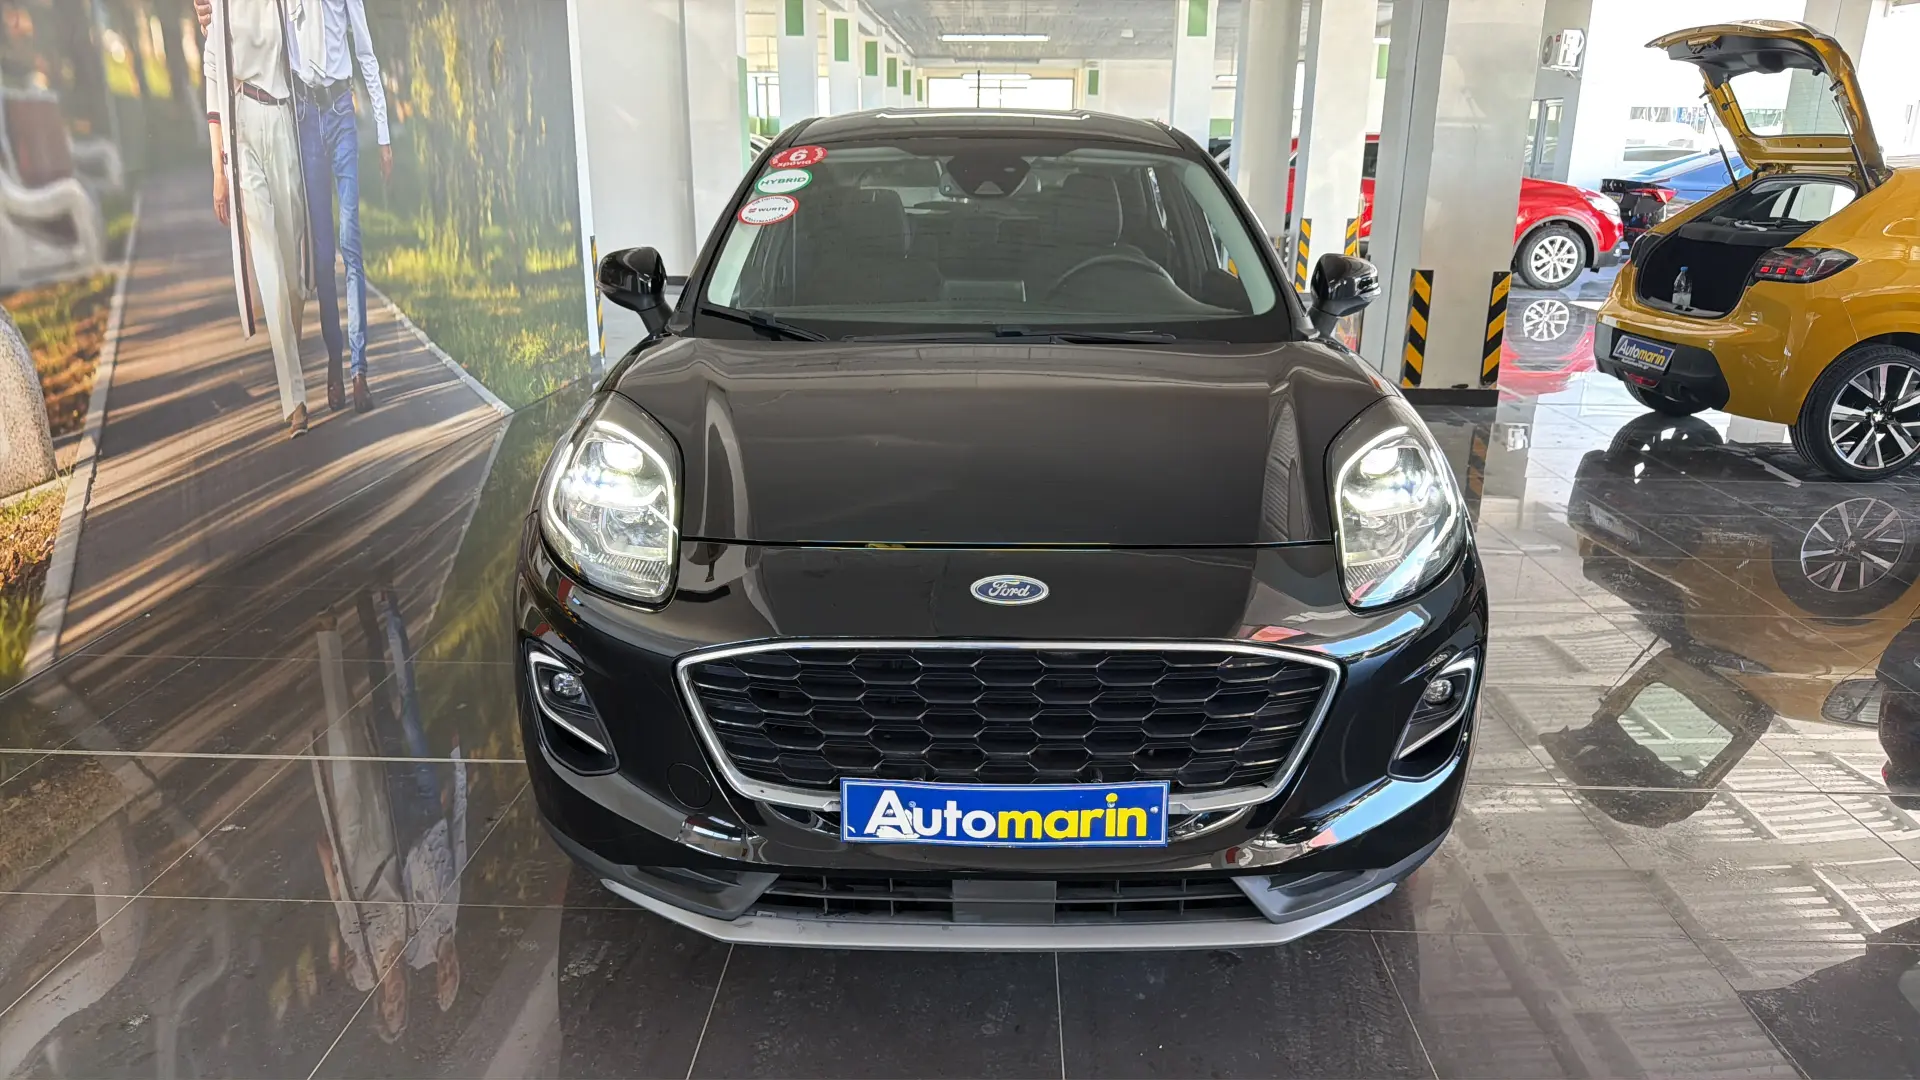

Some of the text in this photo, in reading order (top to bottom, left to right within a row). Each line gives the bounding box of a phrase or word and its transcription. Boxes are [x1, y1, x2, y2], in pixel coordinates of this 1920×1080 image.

[789, 148, 808, 161] 6
[760, 177, 807, 186] HYBRID
[1617, 339, 1666, 366] Automarin
[988, 580, 1031, 597] Ford
[864, 789, 1147, 839] Automarin
